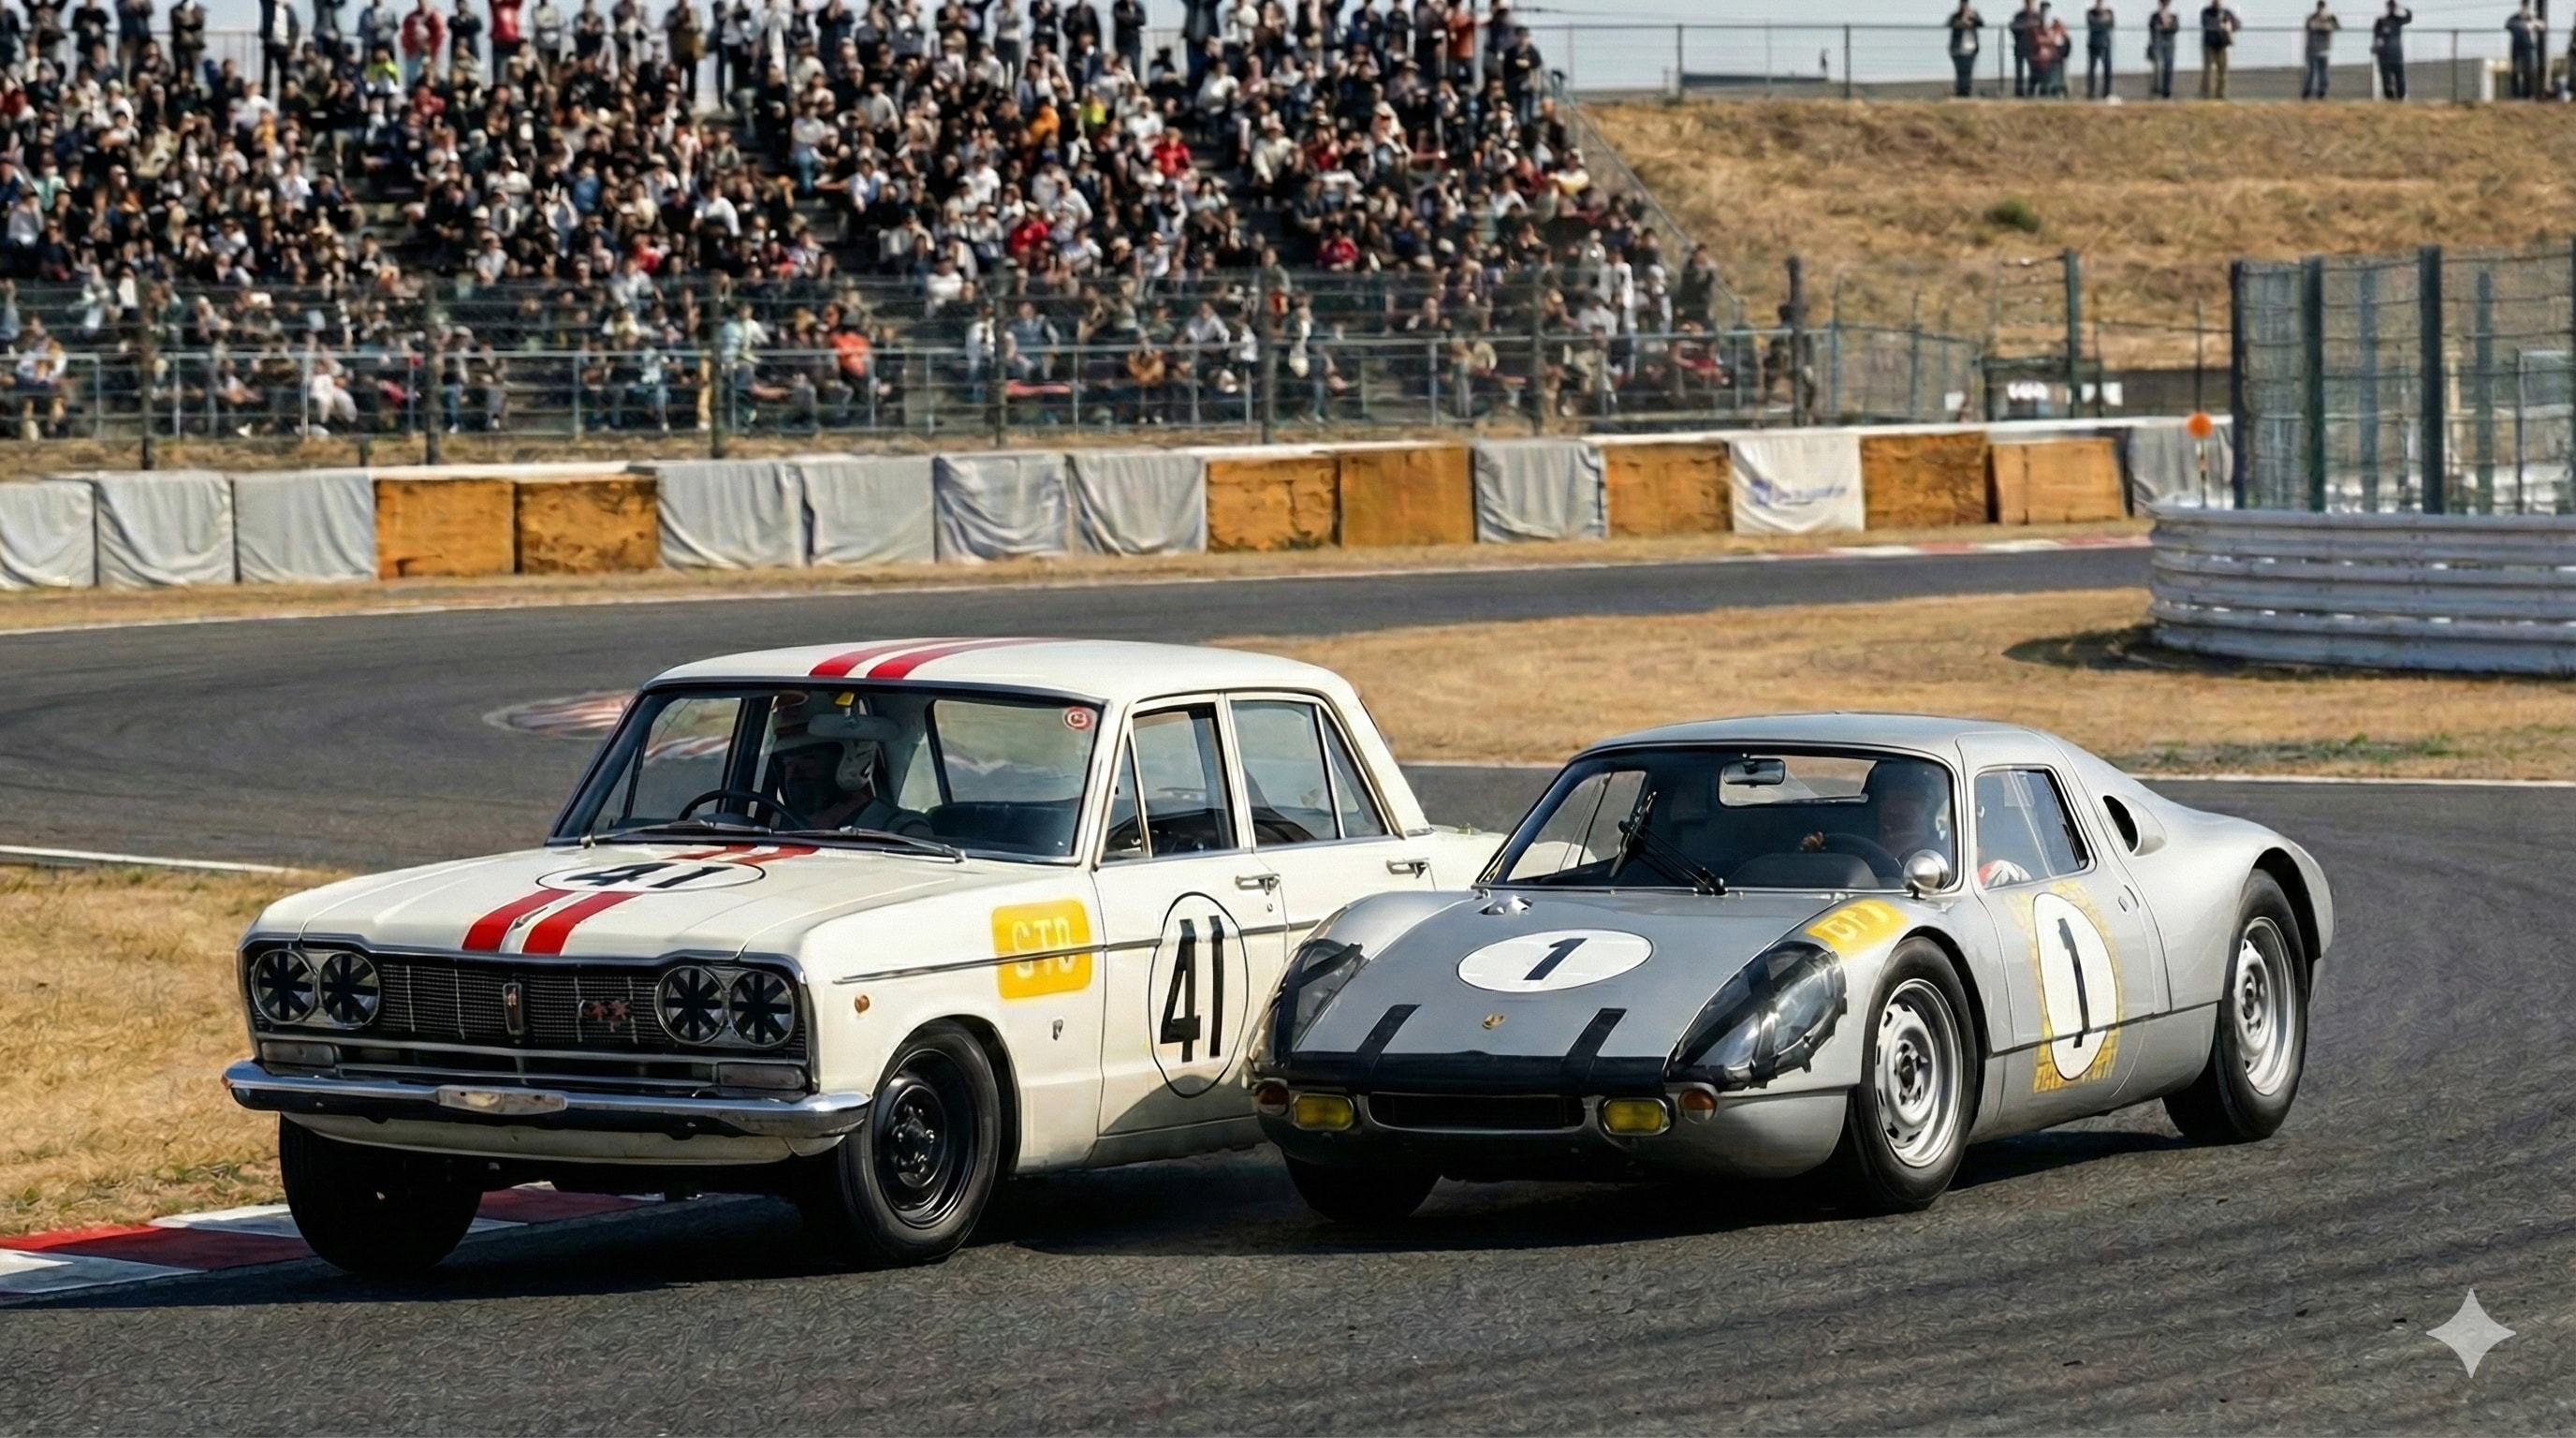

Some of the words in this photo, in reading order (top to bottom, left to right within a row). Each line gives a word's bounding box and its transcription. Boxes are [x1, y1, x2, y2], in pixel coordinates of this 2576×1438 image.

[564, 862, 734, 888] 41
[1160, 915, 1225, 1063] 41
[1523, 937, 1588, 981] 1
[2057, 917, 2090, 1049] 1
